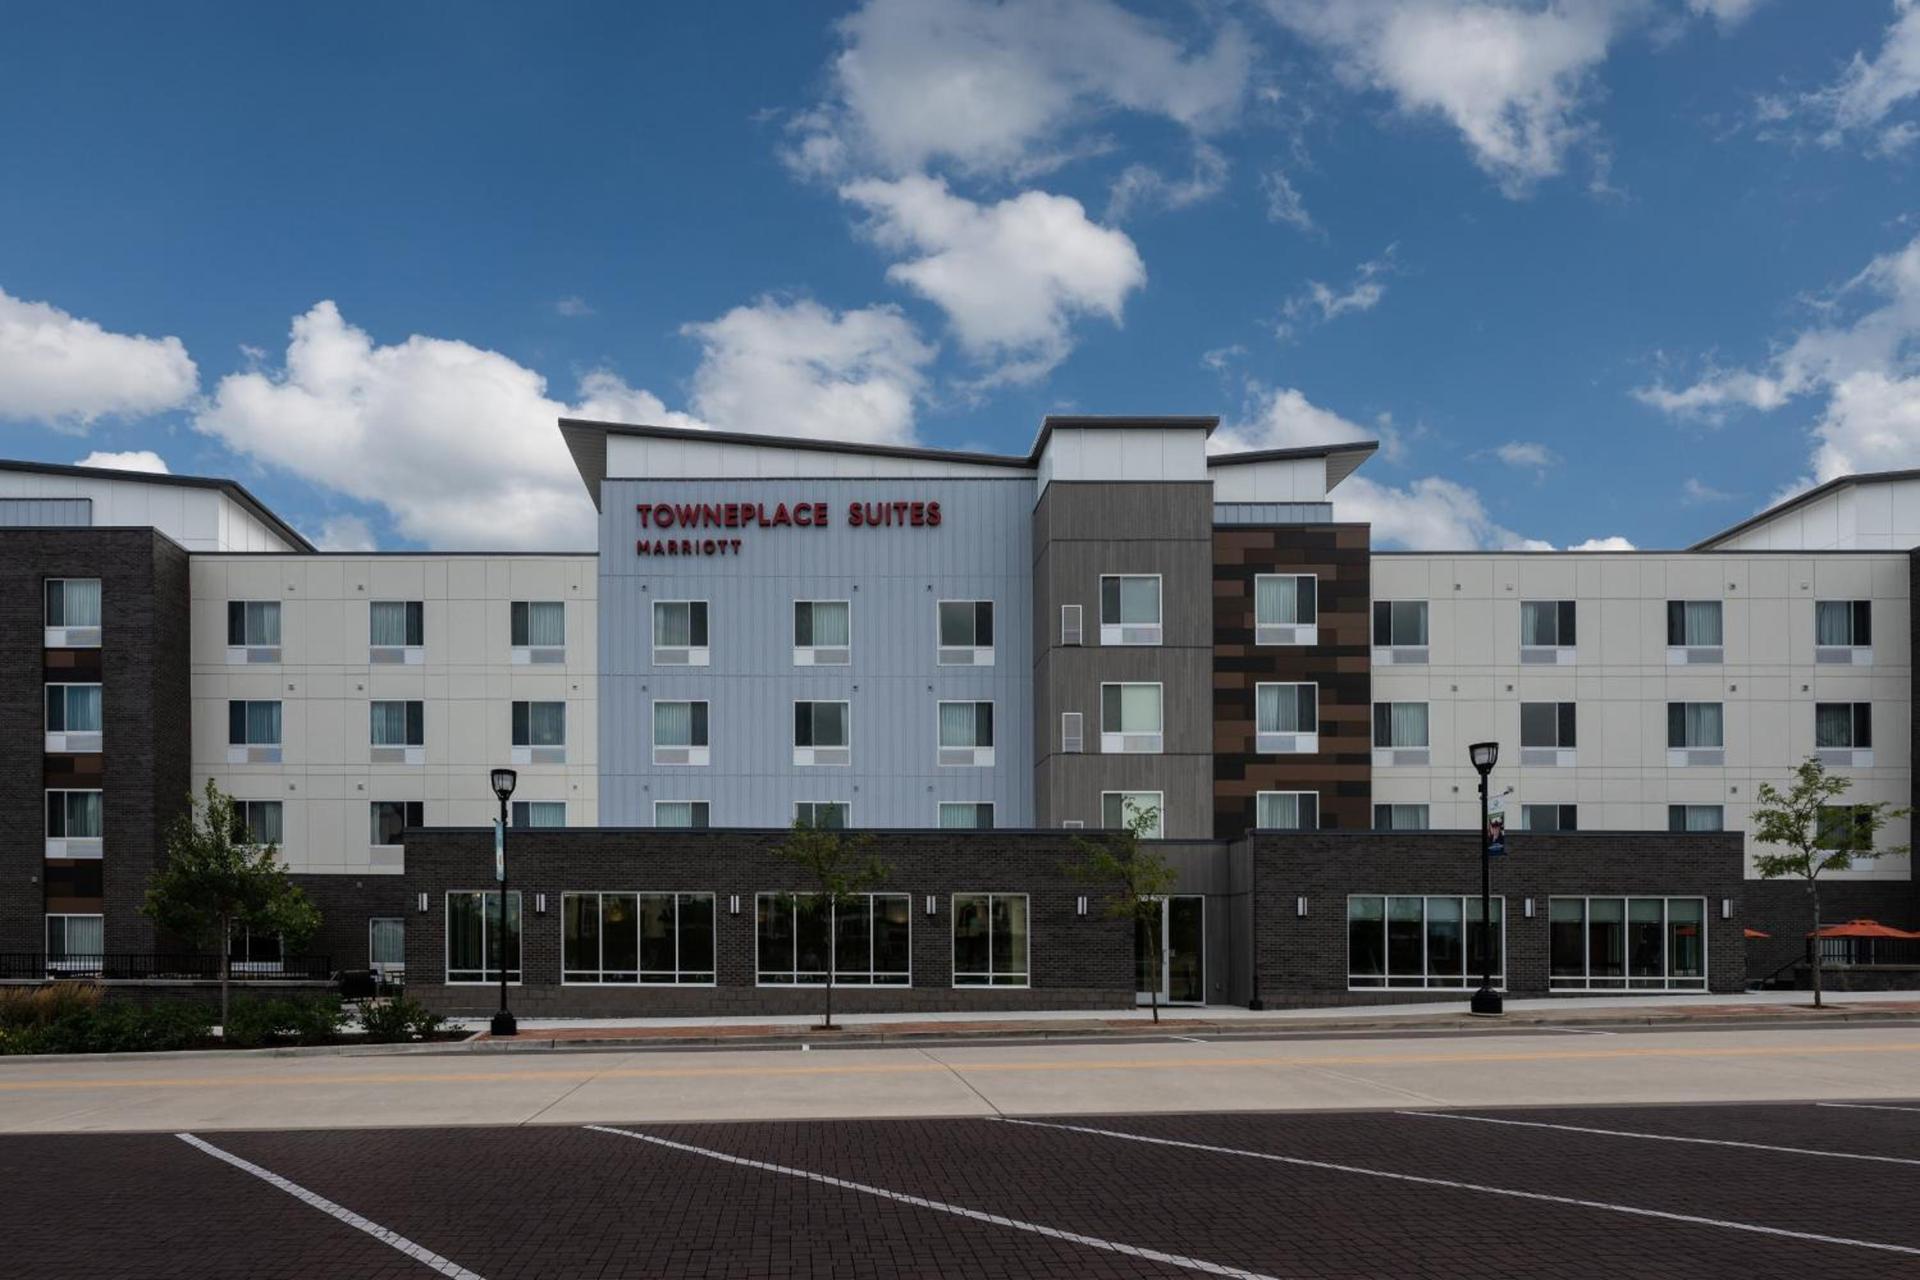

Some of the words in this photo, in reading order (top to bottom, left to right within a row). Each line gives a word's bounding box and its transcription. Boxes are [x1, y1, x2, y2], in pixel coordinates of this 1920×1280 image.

[637, 502, 828, 528] TOWNEPLACE
[848, 502, 942, 526] SUITES
[637, 540, 742, 556] MARRIOTT
